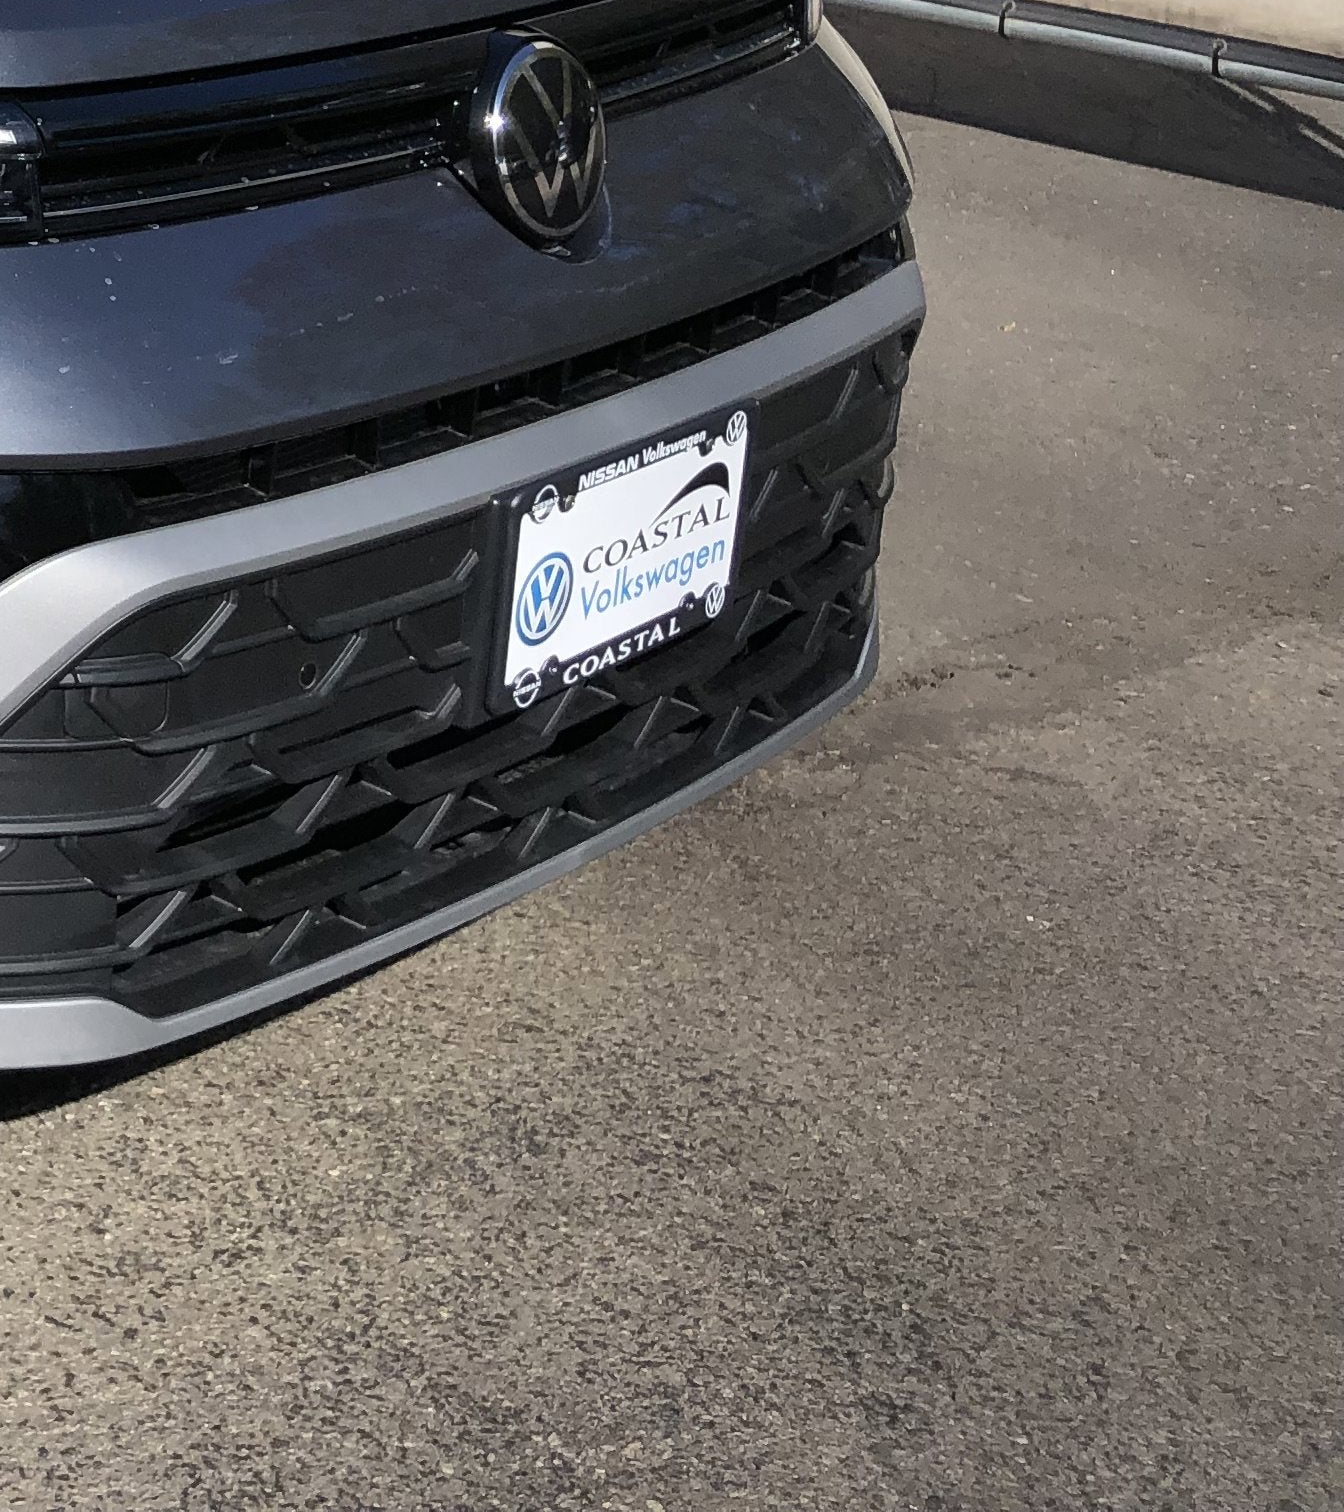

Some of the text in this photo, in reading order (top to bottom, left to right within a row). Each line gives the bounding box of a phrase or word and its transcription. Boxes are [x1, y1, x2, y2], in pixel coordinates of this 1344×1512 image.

[578, 429, 707, 490] NISSAN Volkswagen
[583, 496, 731, 574] COASTAL
[581, 539, 725, 621] Volkswagen
[563, 617, 680, 685] COASTAL
